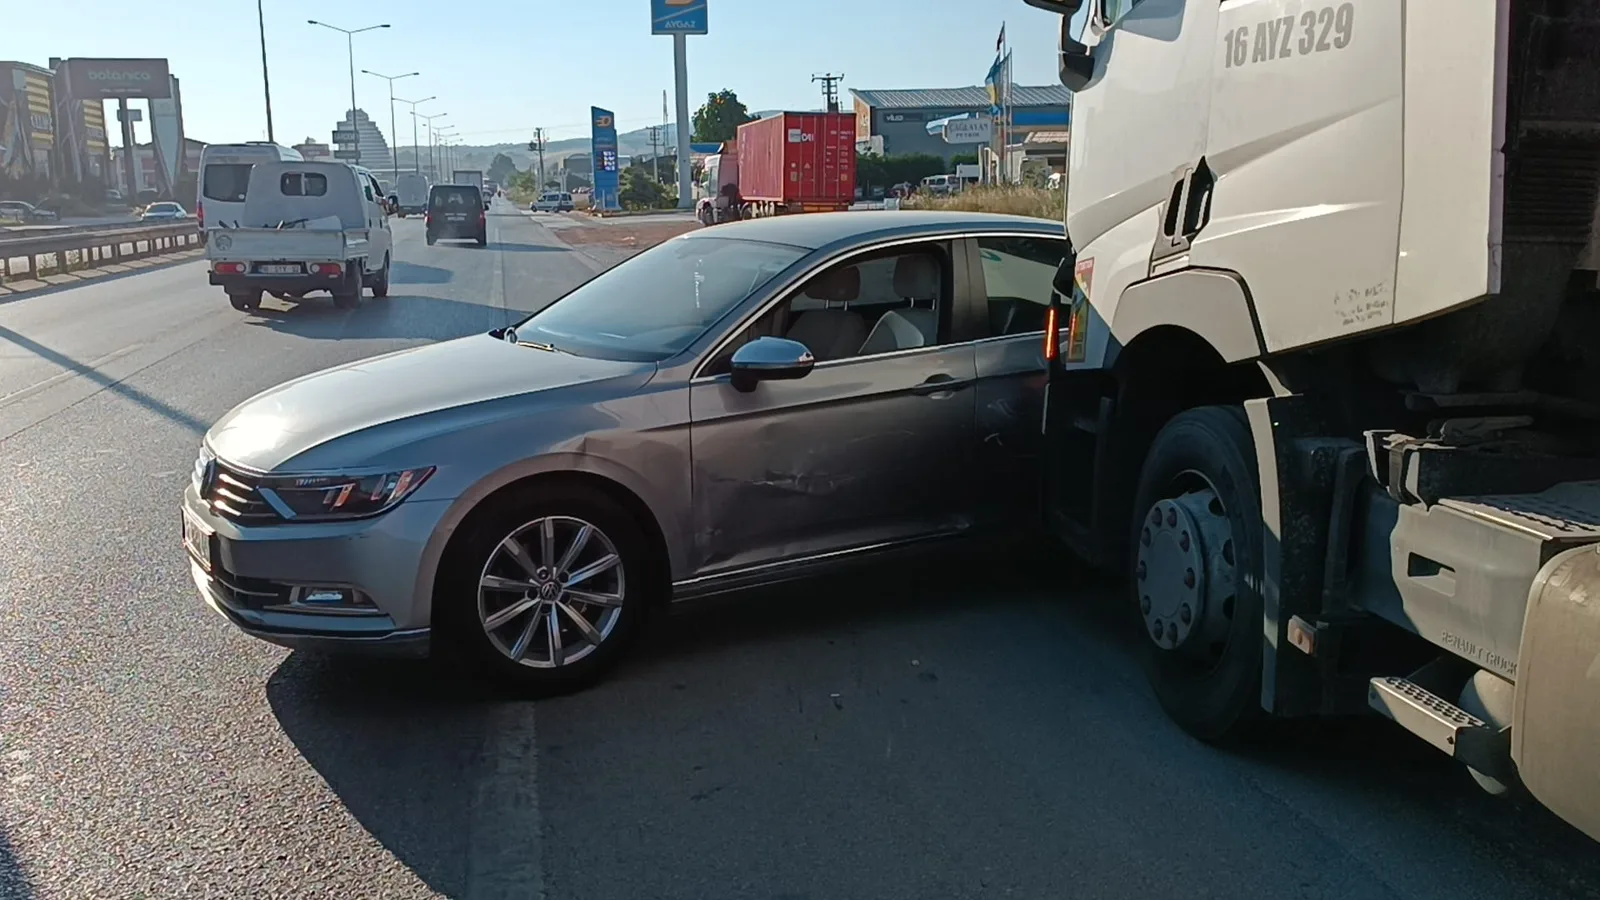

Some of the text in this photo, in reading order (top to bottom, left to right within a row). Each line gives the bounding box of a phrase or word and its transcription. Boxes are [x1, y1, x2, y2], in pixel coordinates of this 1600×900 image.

[664, 20, 696, 29] AYGAZ
[1224, 2, 1354, 68] 16 AYZ 329
[1441, 630, 1483, 660] RENAULT
